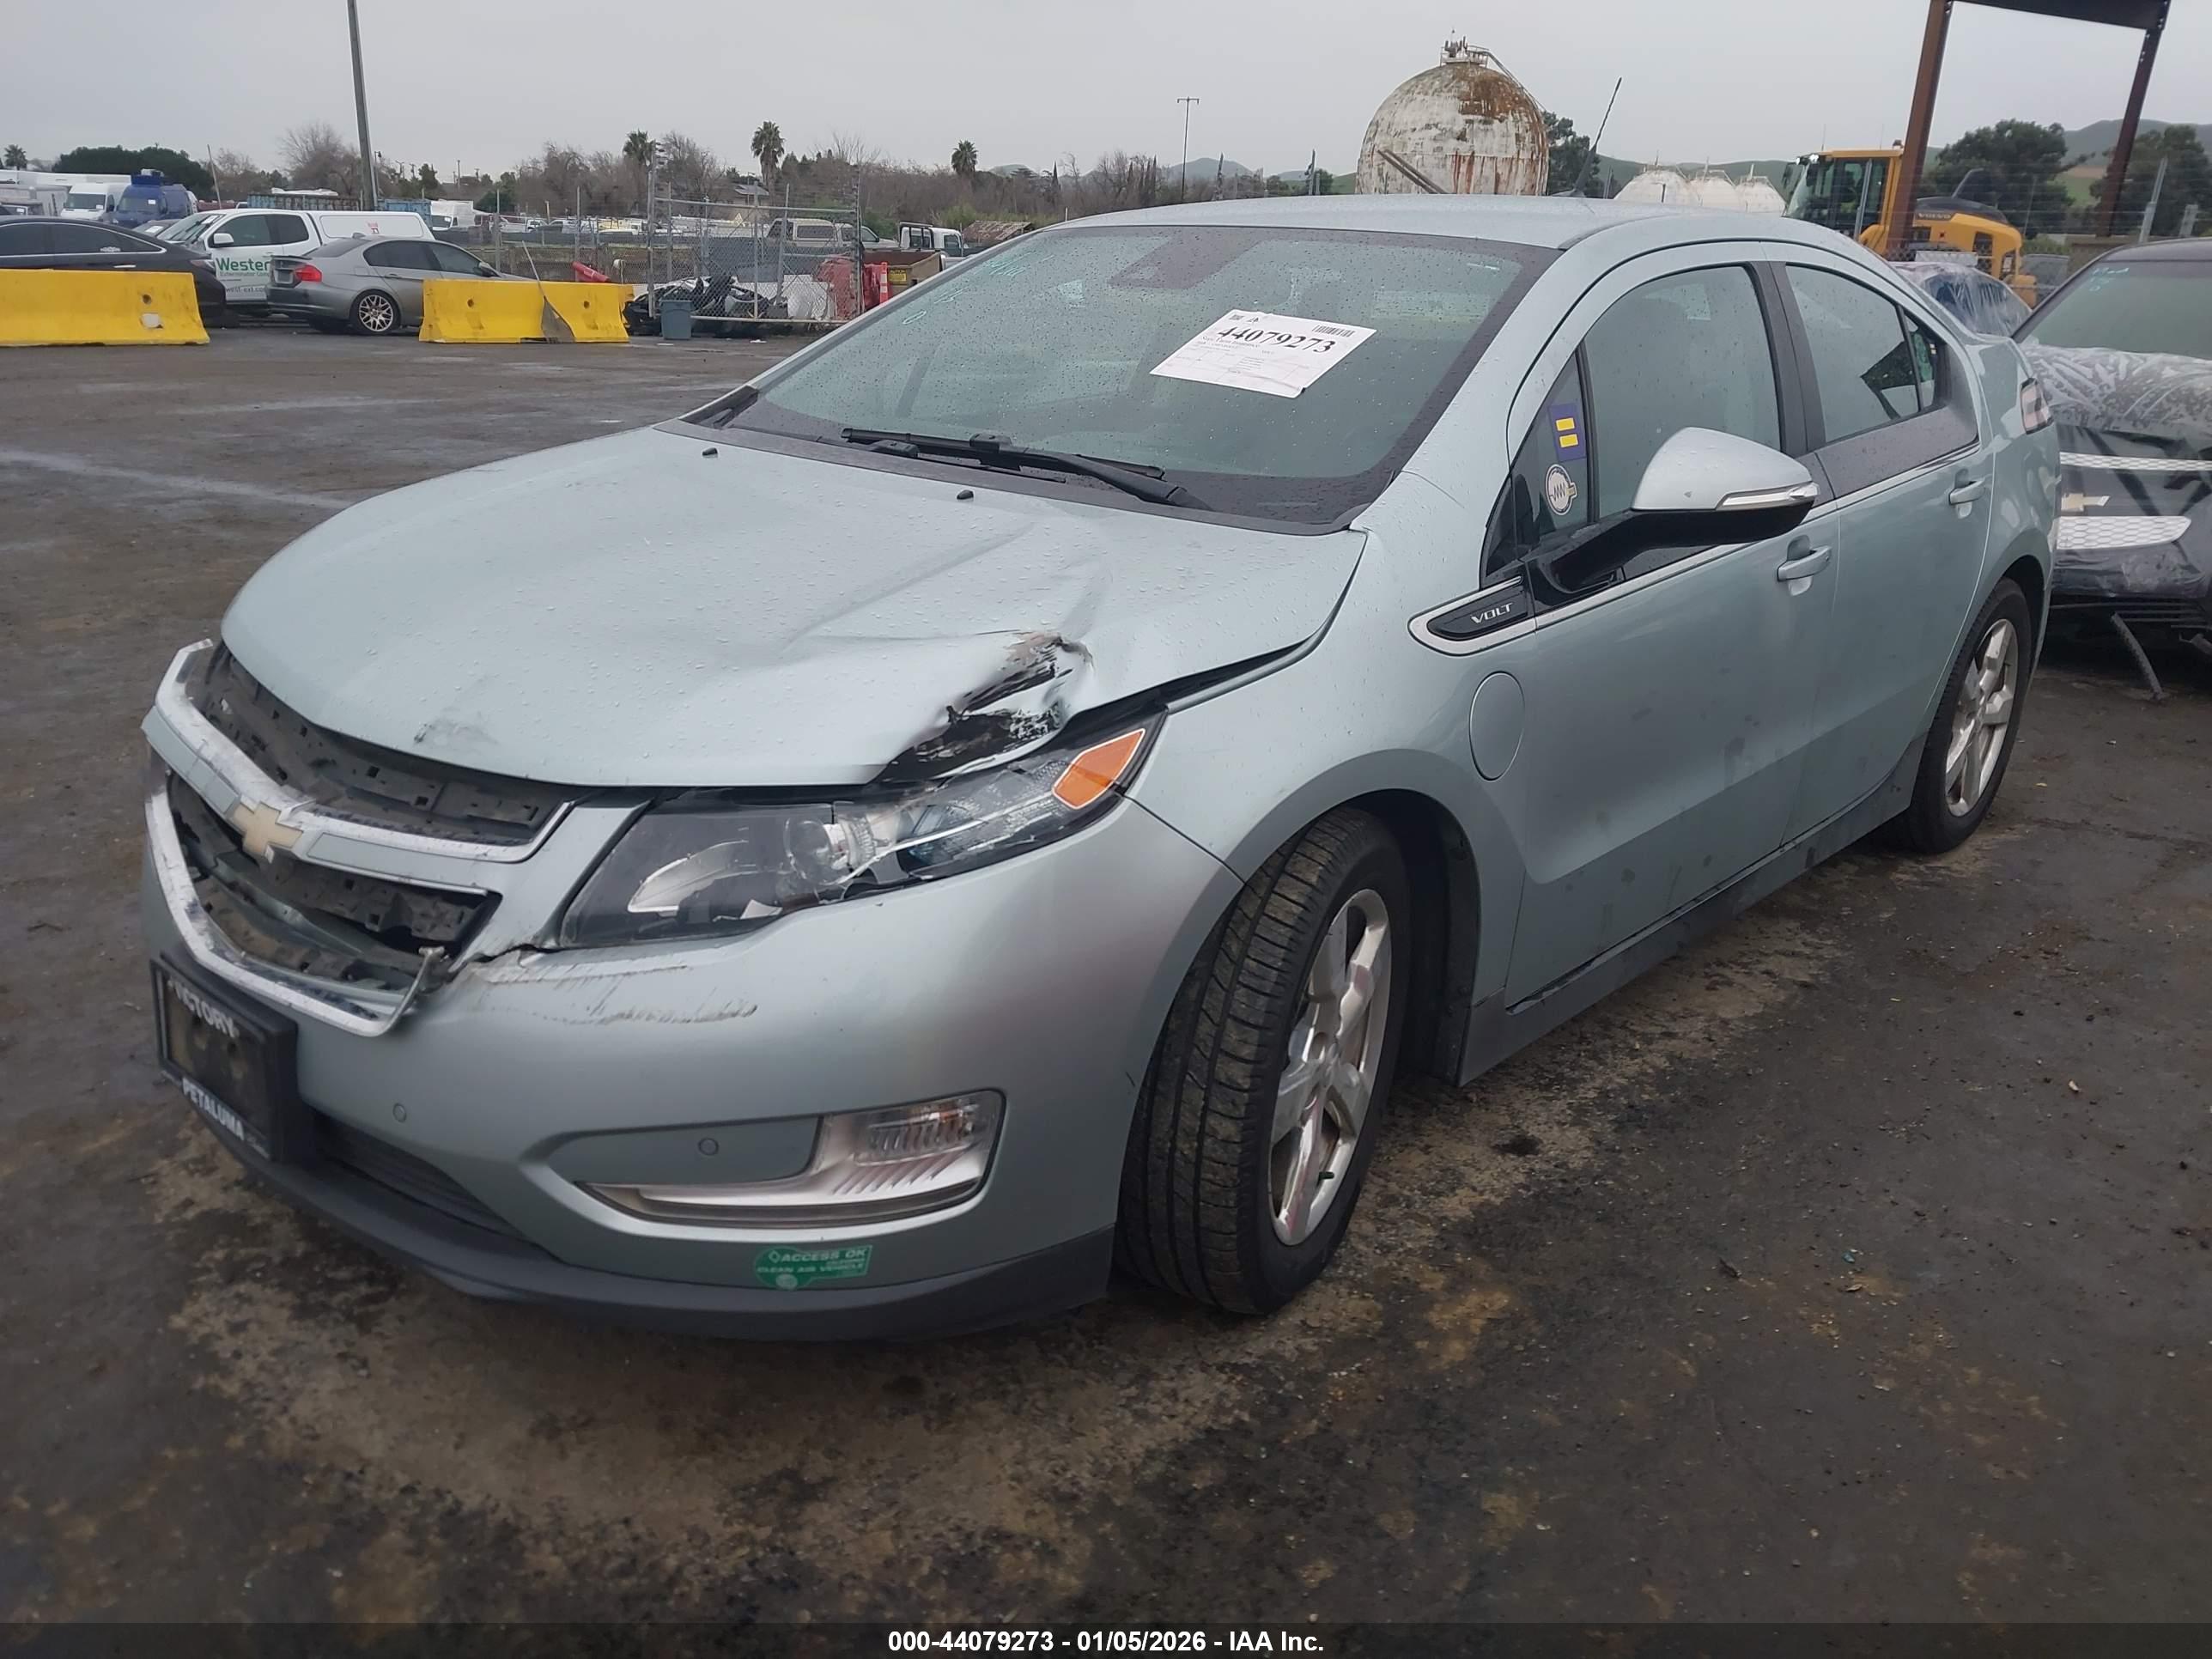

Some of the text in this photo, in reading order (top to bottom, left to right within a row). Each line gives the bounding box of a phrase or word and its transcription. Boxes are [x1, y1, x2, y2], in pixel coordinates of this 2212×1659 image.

[215, 257, 270, 271] Wester
[1218, 325, 1336, 354] 44079273
[1470, 601, 1514, 624] VOLT
[174, 981, 235, 1038] VICTORY
[182, 1076, 245, 1141] PETALUMA
[781, 1251, 840, 1262] ACCESS
[845, 1249, 867, 1259] OK
